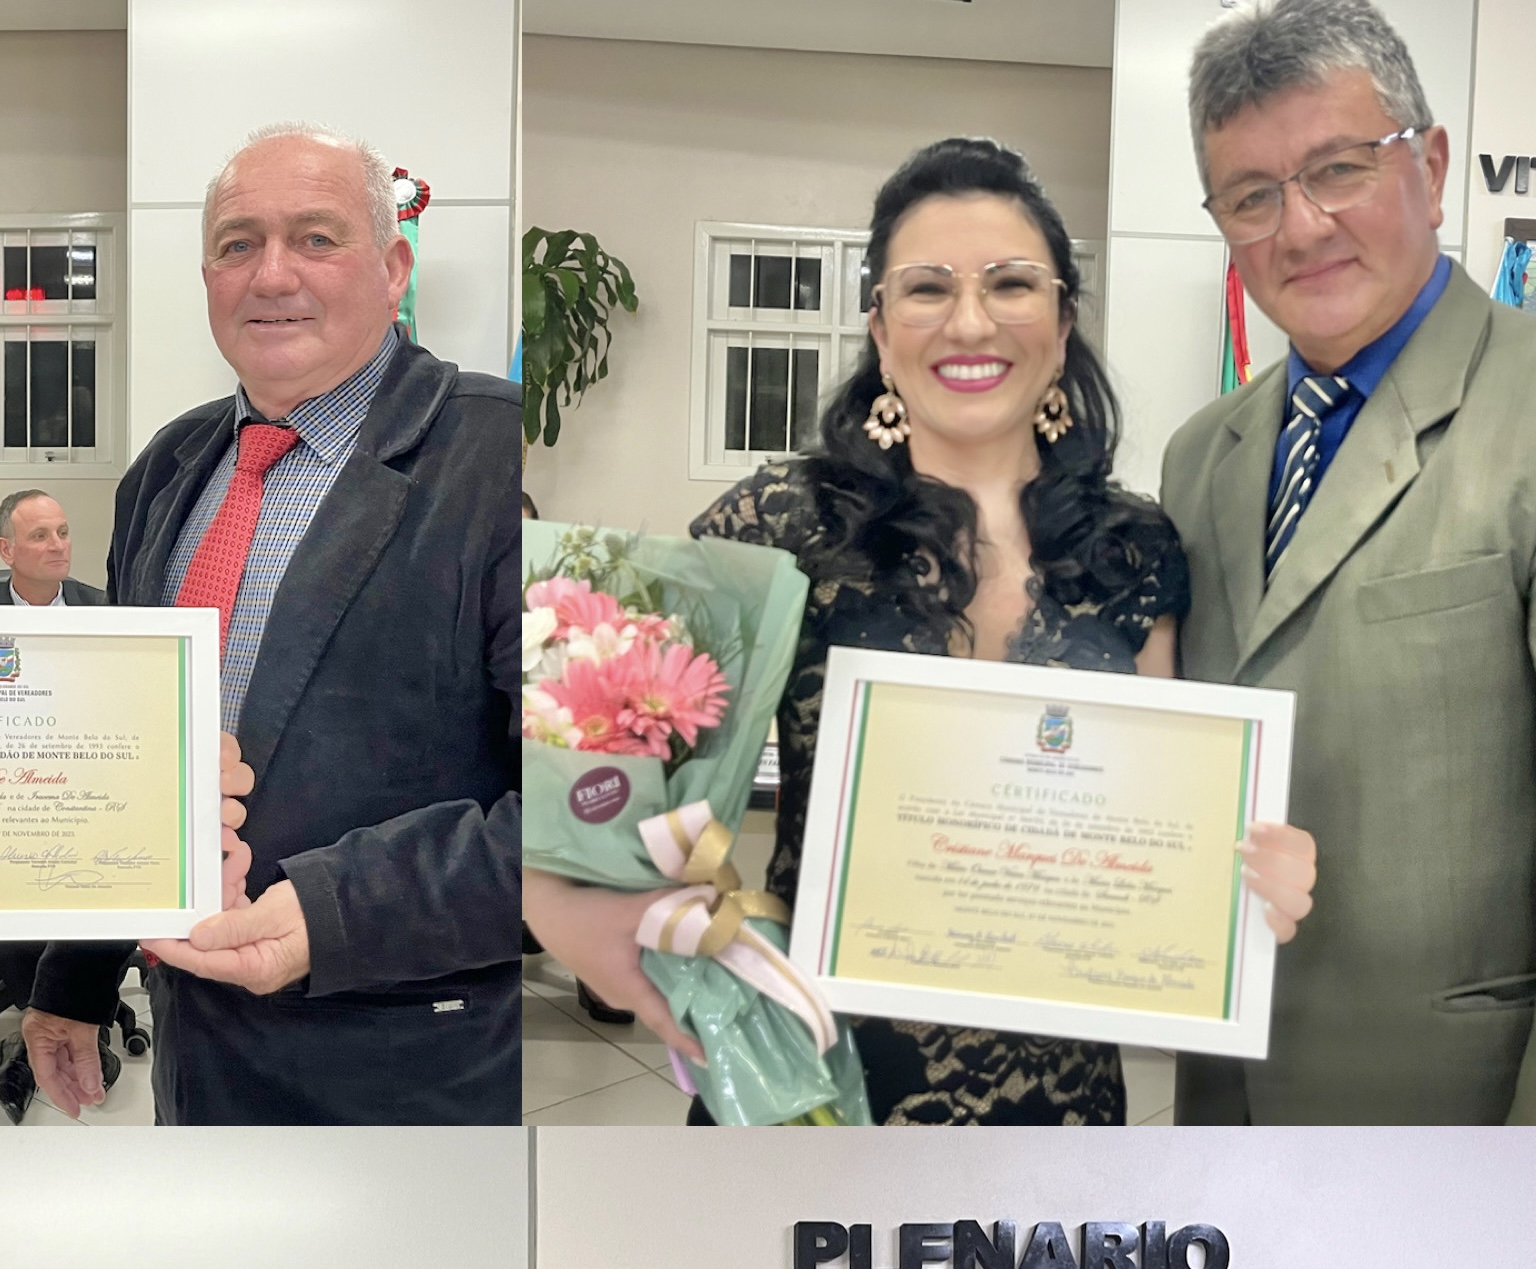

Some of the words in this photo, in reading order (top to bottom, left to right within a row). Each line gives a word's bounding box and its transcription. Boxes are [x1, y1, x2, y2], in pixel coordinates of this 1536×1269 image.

[1478, 153, 1536, 194] VI
[100, 752, 114, 760] DO
[116, 752, 134, 760] SUL
[9, 767, 69, 784] Almeida
[991, 783, 1106, 806] CERTIFICADO
[52, 817, 89, 825] Município.
